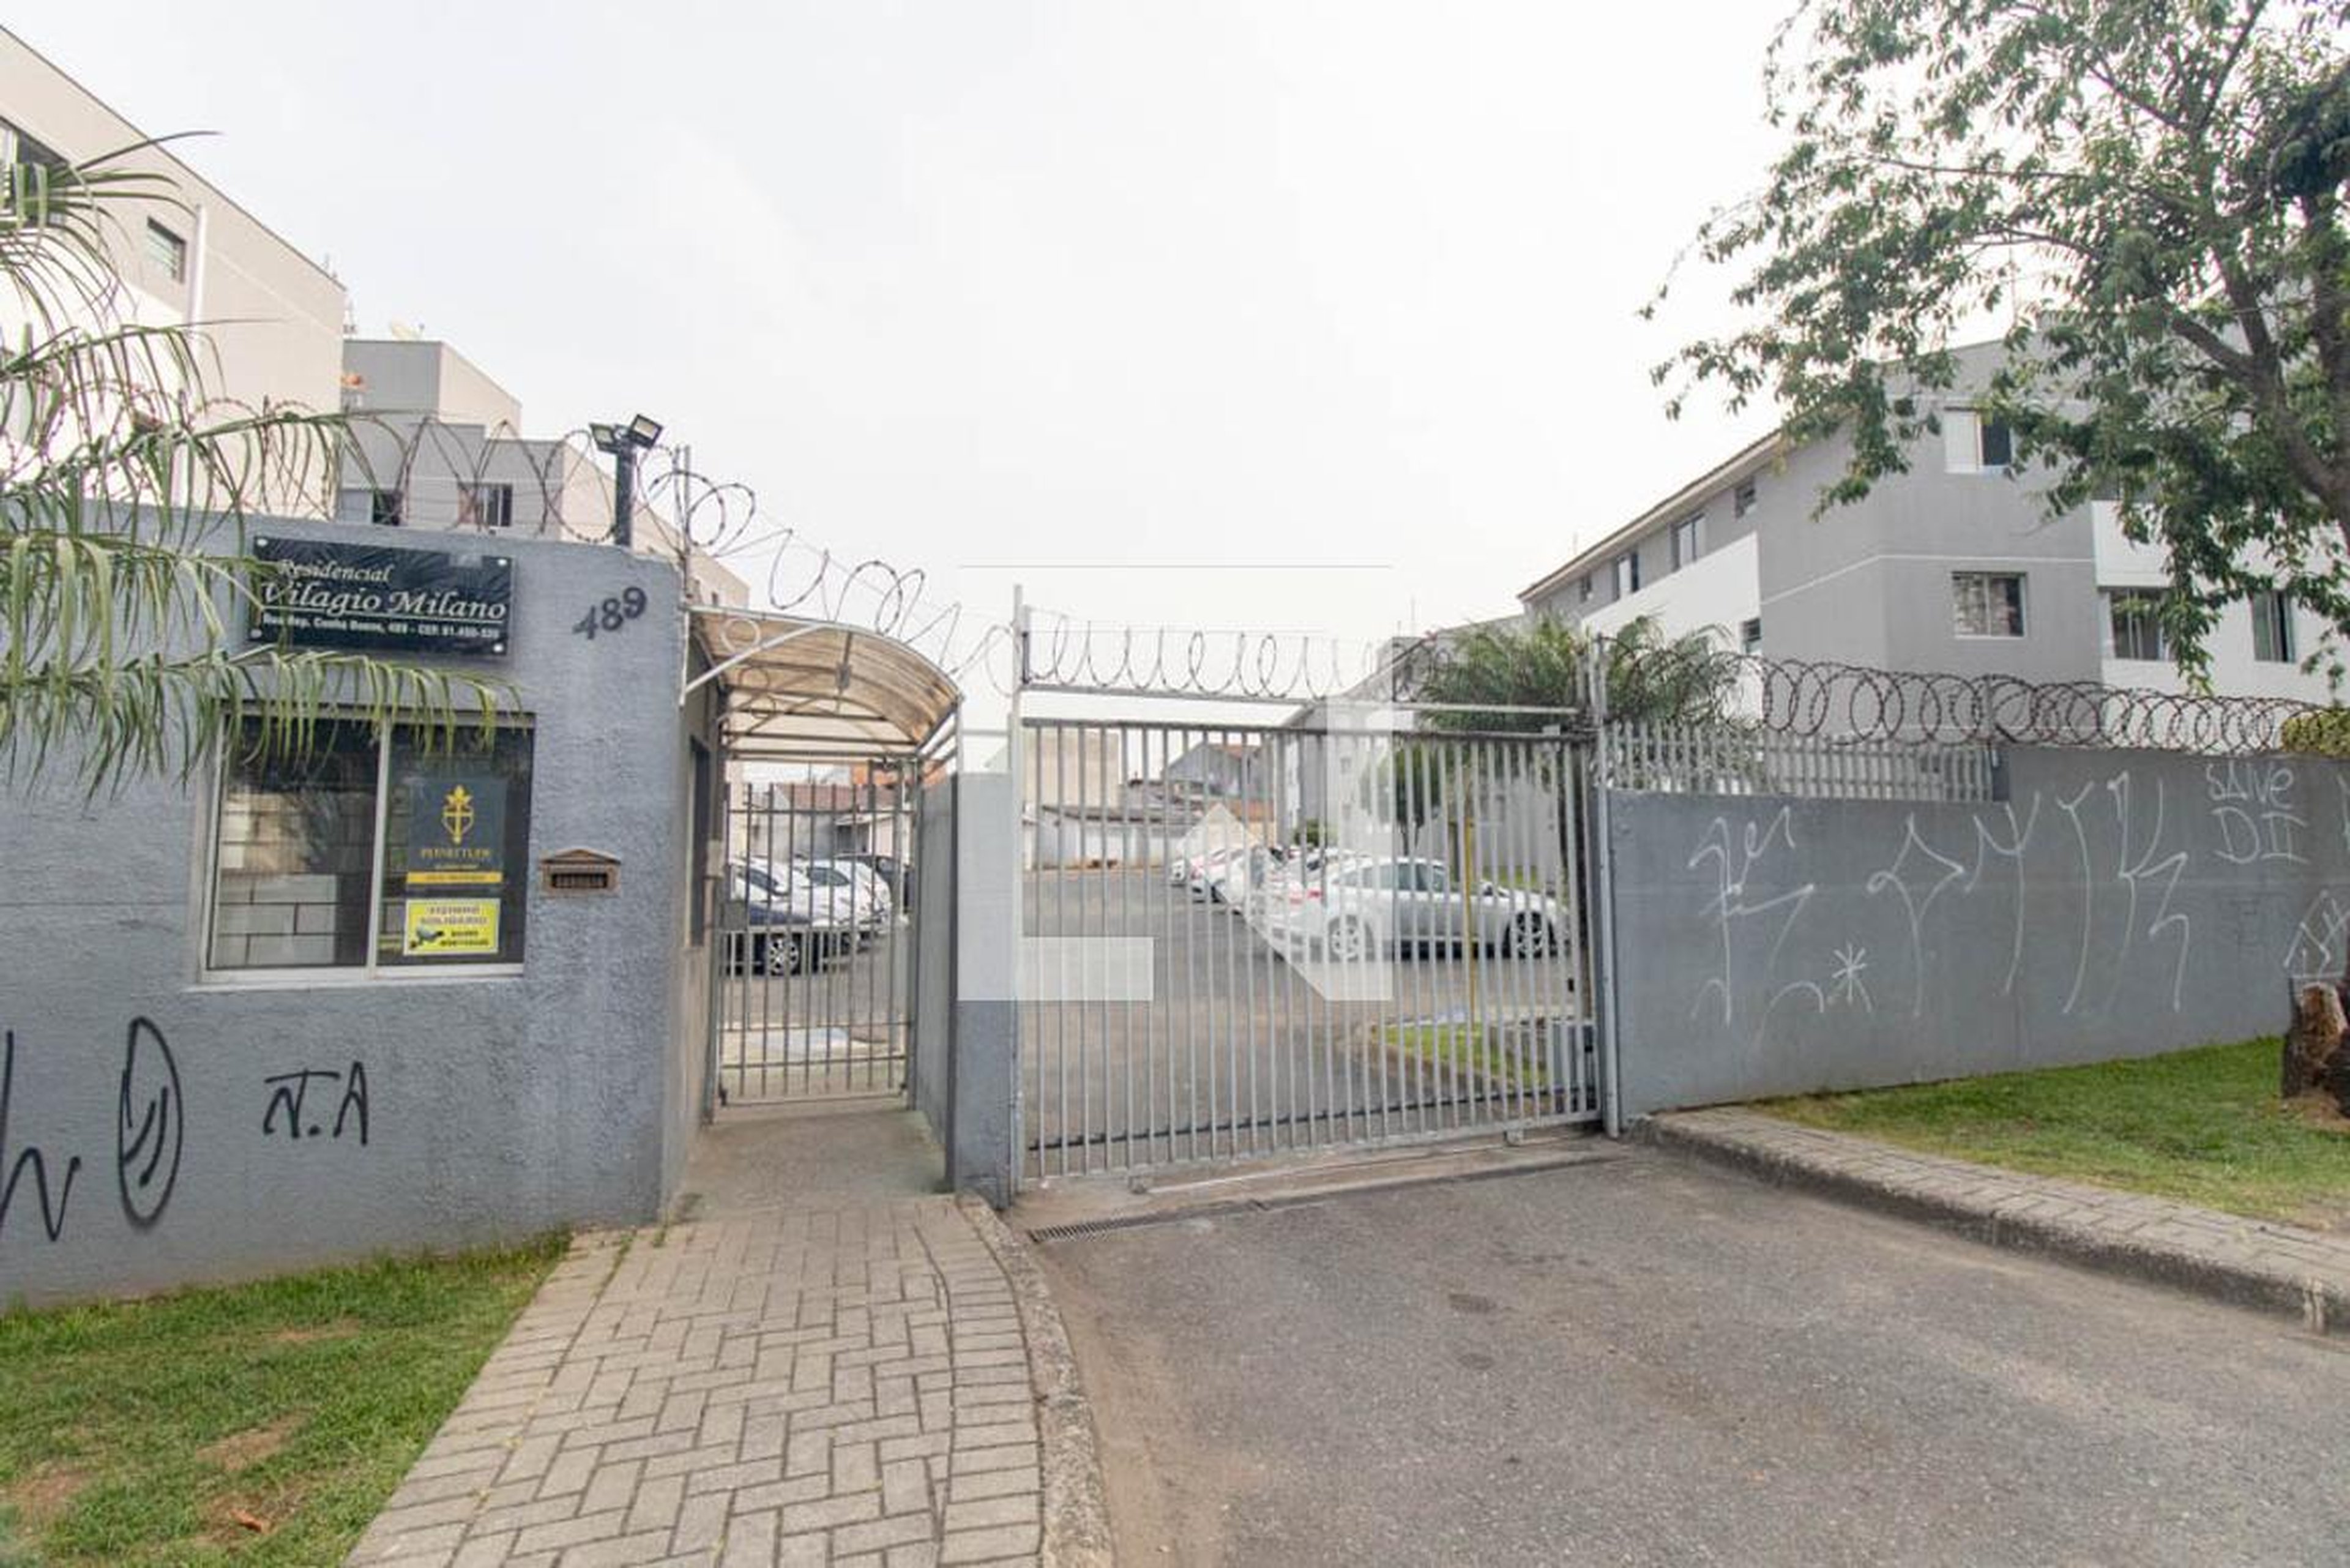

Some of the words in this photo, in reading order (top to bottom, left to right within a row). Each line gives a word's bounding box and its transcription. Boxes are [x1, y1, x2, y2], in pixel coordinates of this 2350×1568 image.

[277, 559, 395, 581] Residencial
[262, 581, 381, 617] Vilagio
[388, 591, 506, 620] Milano
[572, 586, 647, 640] 489
